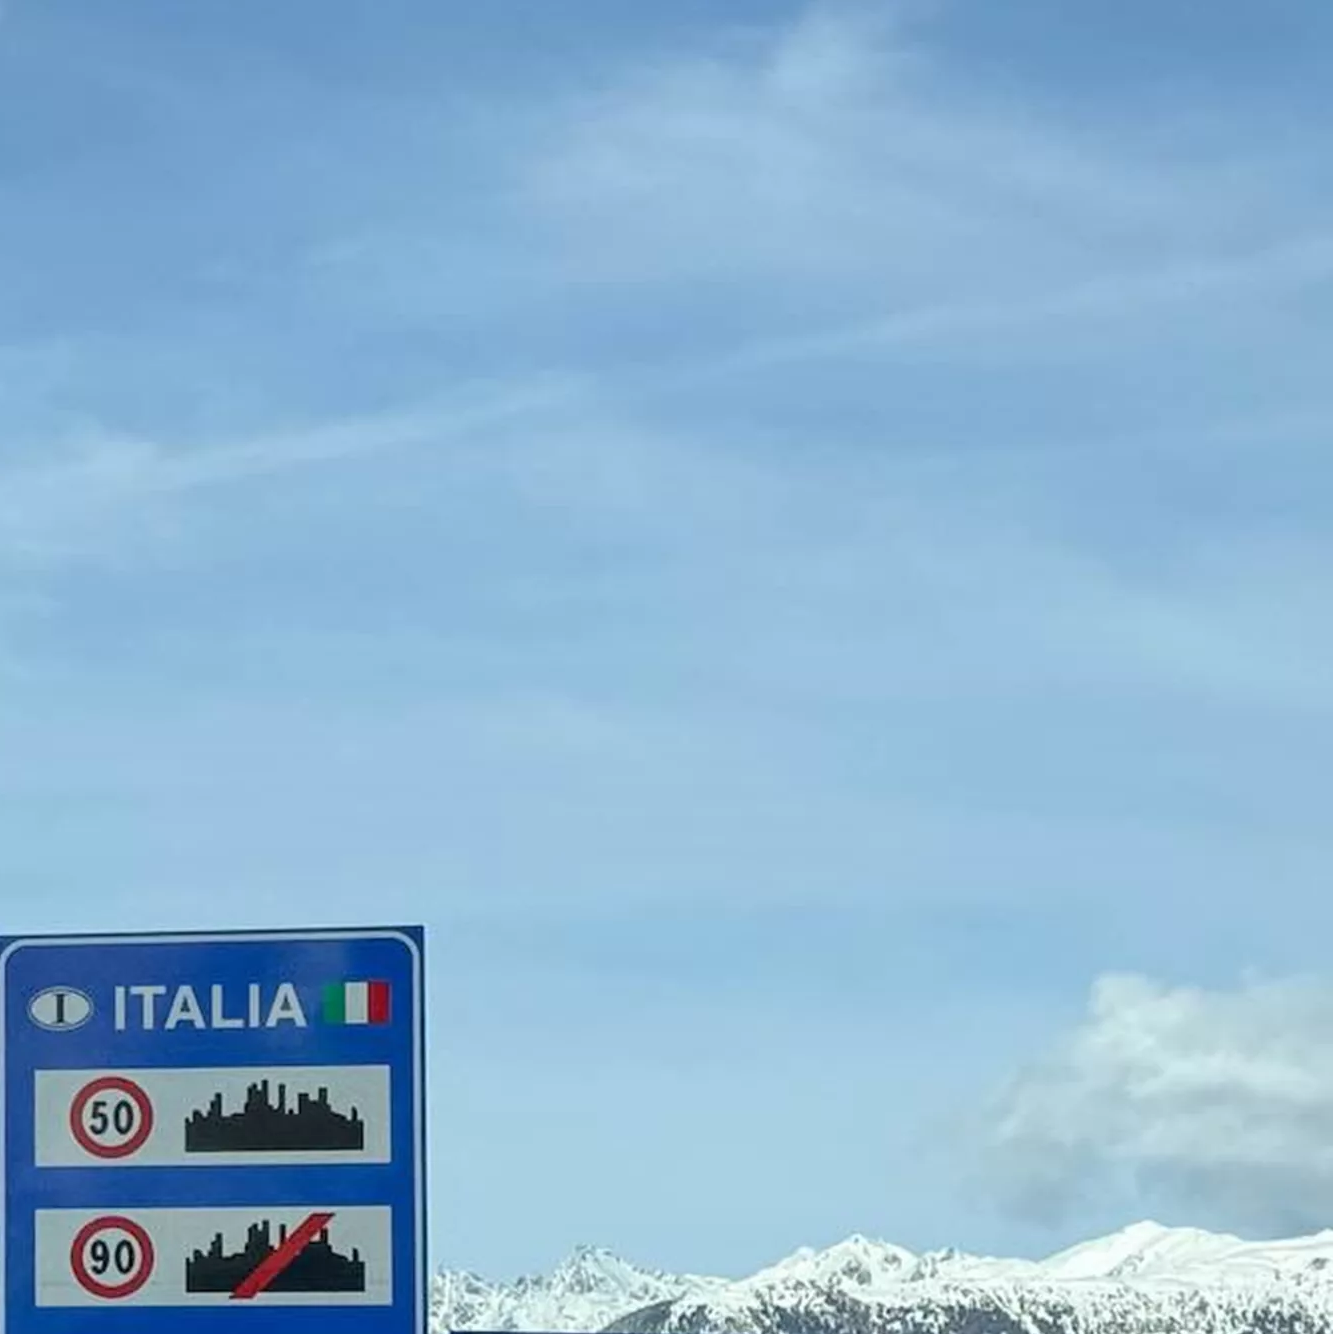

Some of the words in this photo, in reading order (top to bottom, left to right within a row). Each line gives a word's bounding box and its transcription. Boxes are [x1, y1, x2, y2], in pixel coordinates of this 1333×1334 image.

[54, 993, 66, 1024] I
[114, 982, 307, 1030] ITALIA
[89, 1100, 134, 1135] 50
[90, 1239, 135, 1275] 90
